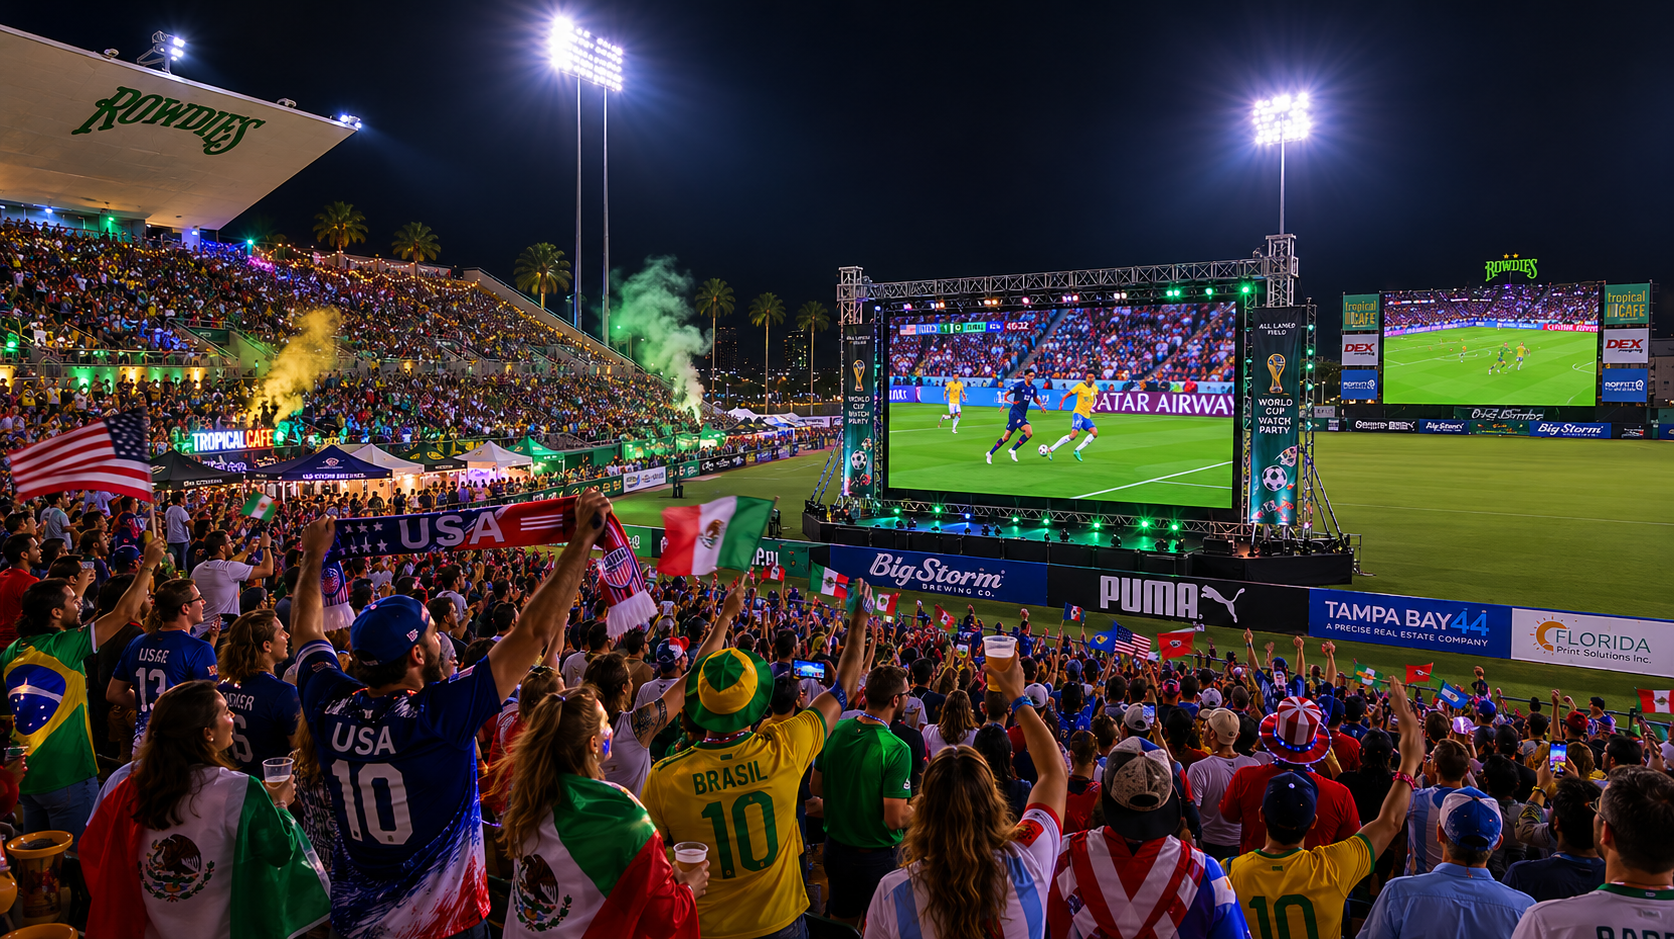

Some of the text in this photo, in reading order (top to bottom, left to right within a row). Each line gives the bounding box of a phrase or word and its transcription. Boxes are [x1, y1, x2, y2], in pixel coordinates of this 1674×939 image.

[71, 86, 266, 155] ROWDIES
[1485, 259, 1538, 282] ROWDIES
[1345, 300, 1376, 312] tropical
[1607, 290, 1645, 303] tropical
[1619, 304, 1645, 318] CAFE
[1344, 343, 1375, 352] DEX
[1605, 339, 1644, 349] DEX
[1093, 393, 1150, 412] ATAR
[1265, 407, 1285, 415] CUP
[1258, 417, 1292, 425] WATCH
[1259, 426, 1291, 434] PARTY
[1537, 423, 1561, 435] Big
[191, 429, 274, 451] TROPICAL CAFE
[399, 511, 505, 549] USA
[869, 552, 1002, 589] Big Storm
[978, 589, 995, 597] CO.
[1100, 575, 1198, 619] PUMA
[1324, 601, 1400, 626] TAMPA
[1334, 623, 1371, 634] PRECISE
[1374, 628, 1398, 638] REAL
[1400, 631, 1435, 641] ESTATE
[1438, 635, 1489, 647] COMPANY
[1556, 629, 1651, 653] FLORIDA
[1556, 645, 1652, 664] Print Solutions Inc.
[331, 722, 396, 756] USA
[692, 760, 768, 795] BRASIL
[331, 758, 413, 845] 10
[701, 790, 779, 880] 10
[1248, 893, 1320, 939] 10
